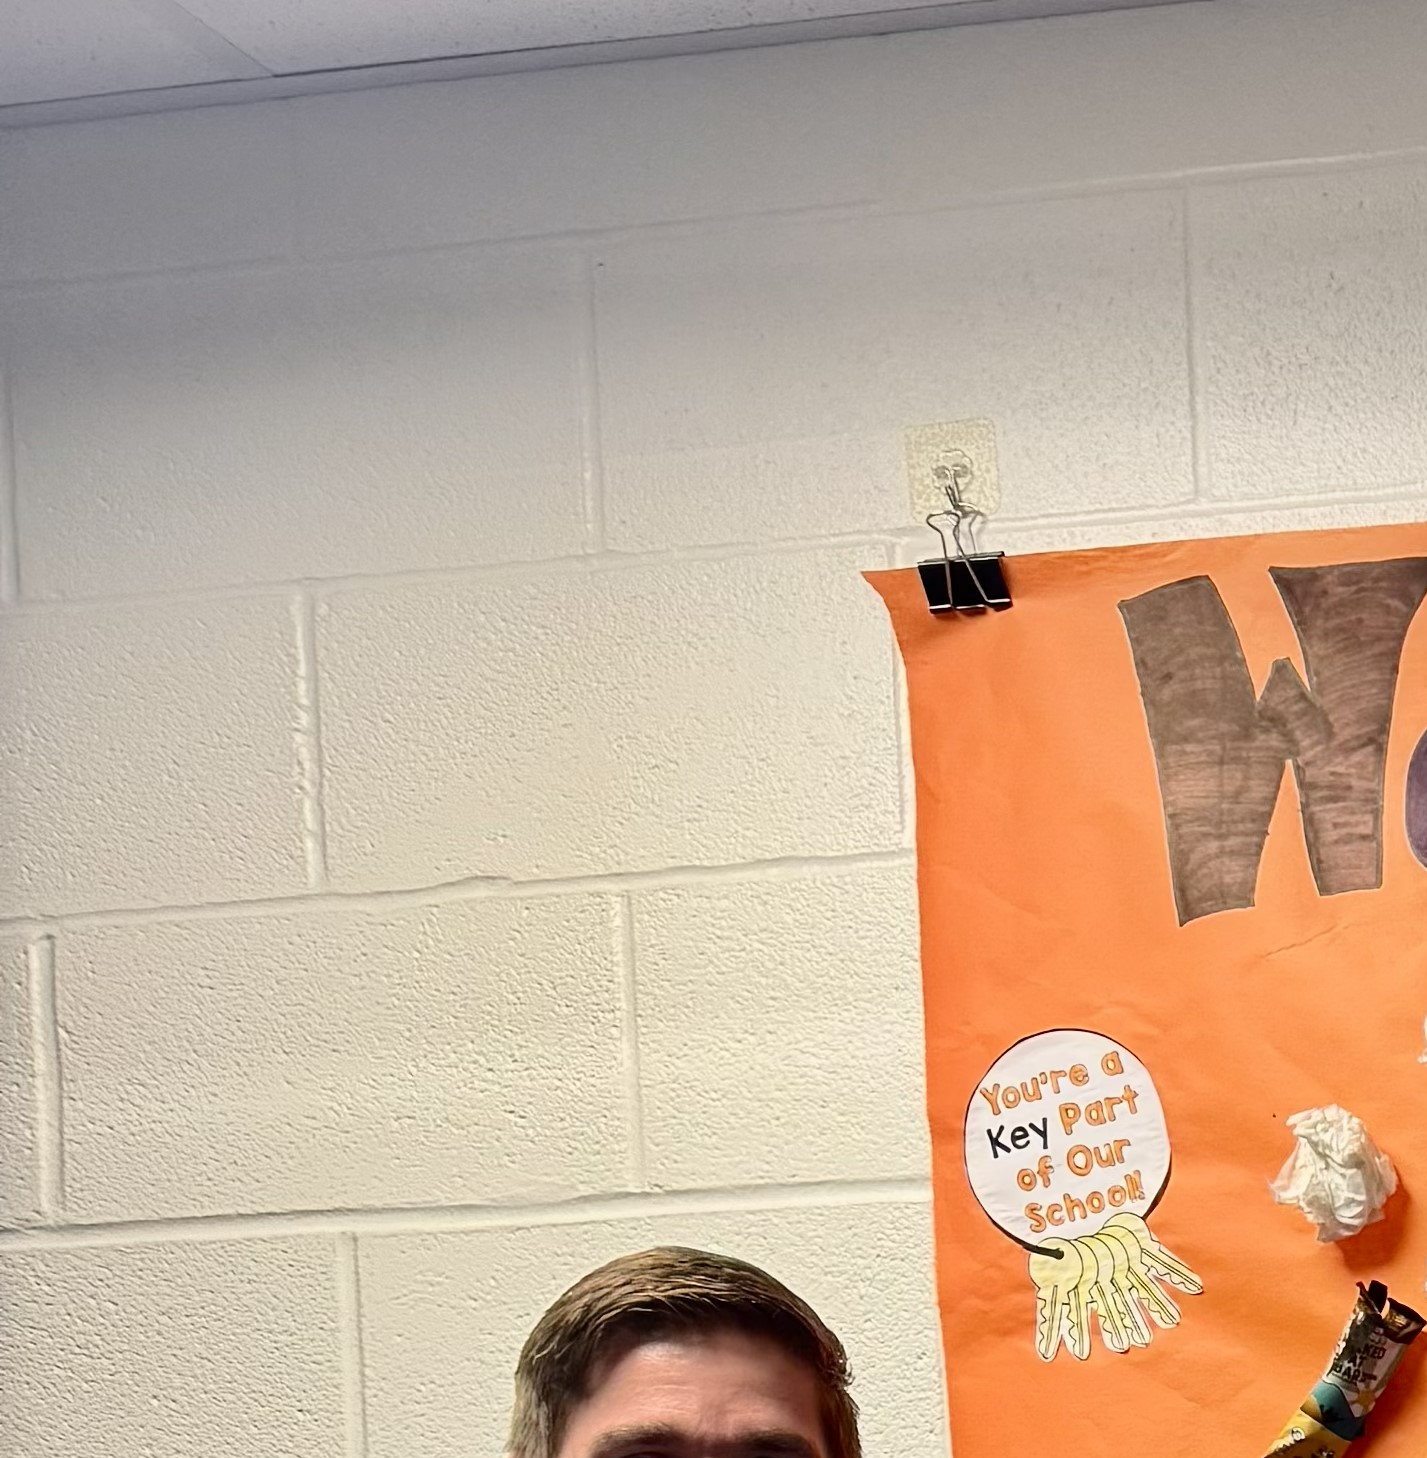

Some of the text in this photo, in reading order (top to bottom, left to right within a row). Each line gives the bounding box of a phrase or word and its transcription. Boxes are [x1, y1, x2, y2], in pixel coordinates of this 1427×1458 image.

[979, 1051, 1125, 1116] You're a
[986, 1084, 1139, 1159] Key Part
[1016, 1138, 1131, 1192] of Our
